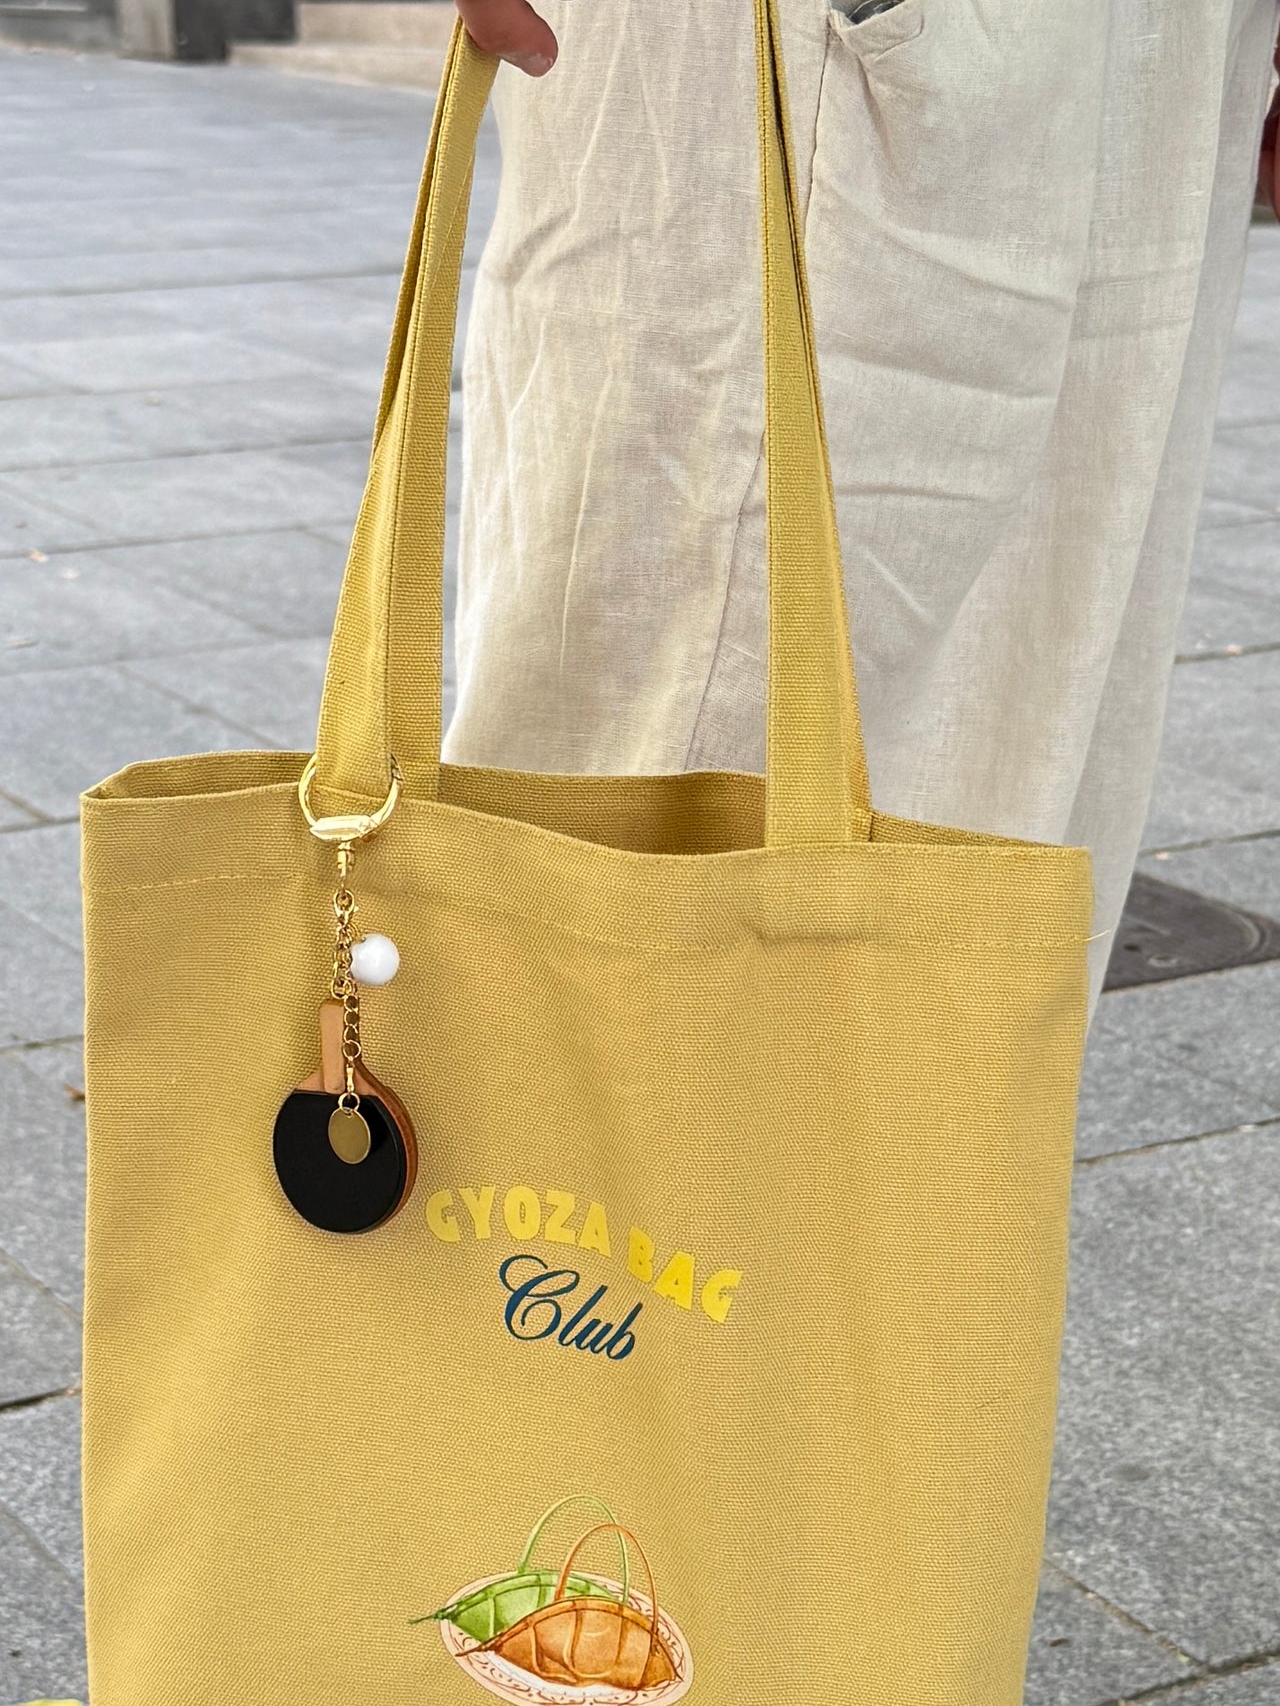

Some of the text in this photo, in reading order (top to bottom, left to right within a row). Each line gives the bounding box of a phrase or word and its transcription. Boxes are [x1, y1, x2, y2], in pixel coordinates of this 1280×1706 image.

[424, 1185, 743, 1324] GYOZA BAG
[498, 1254, 643, 1361] Club
